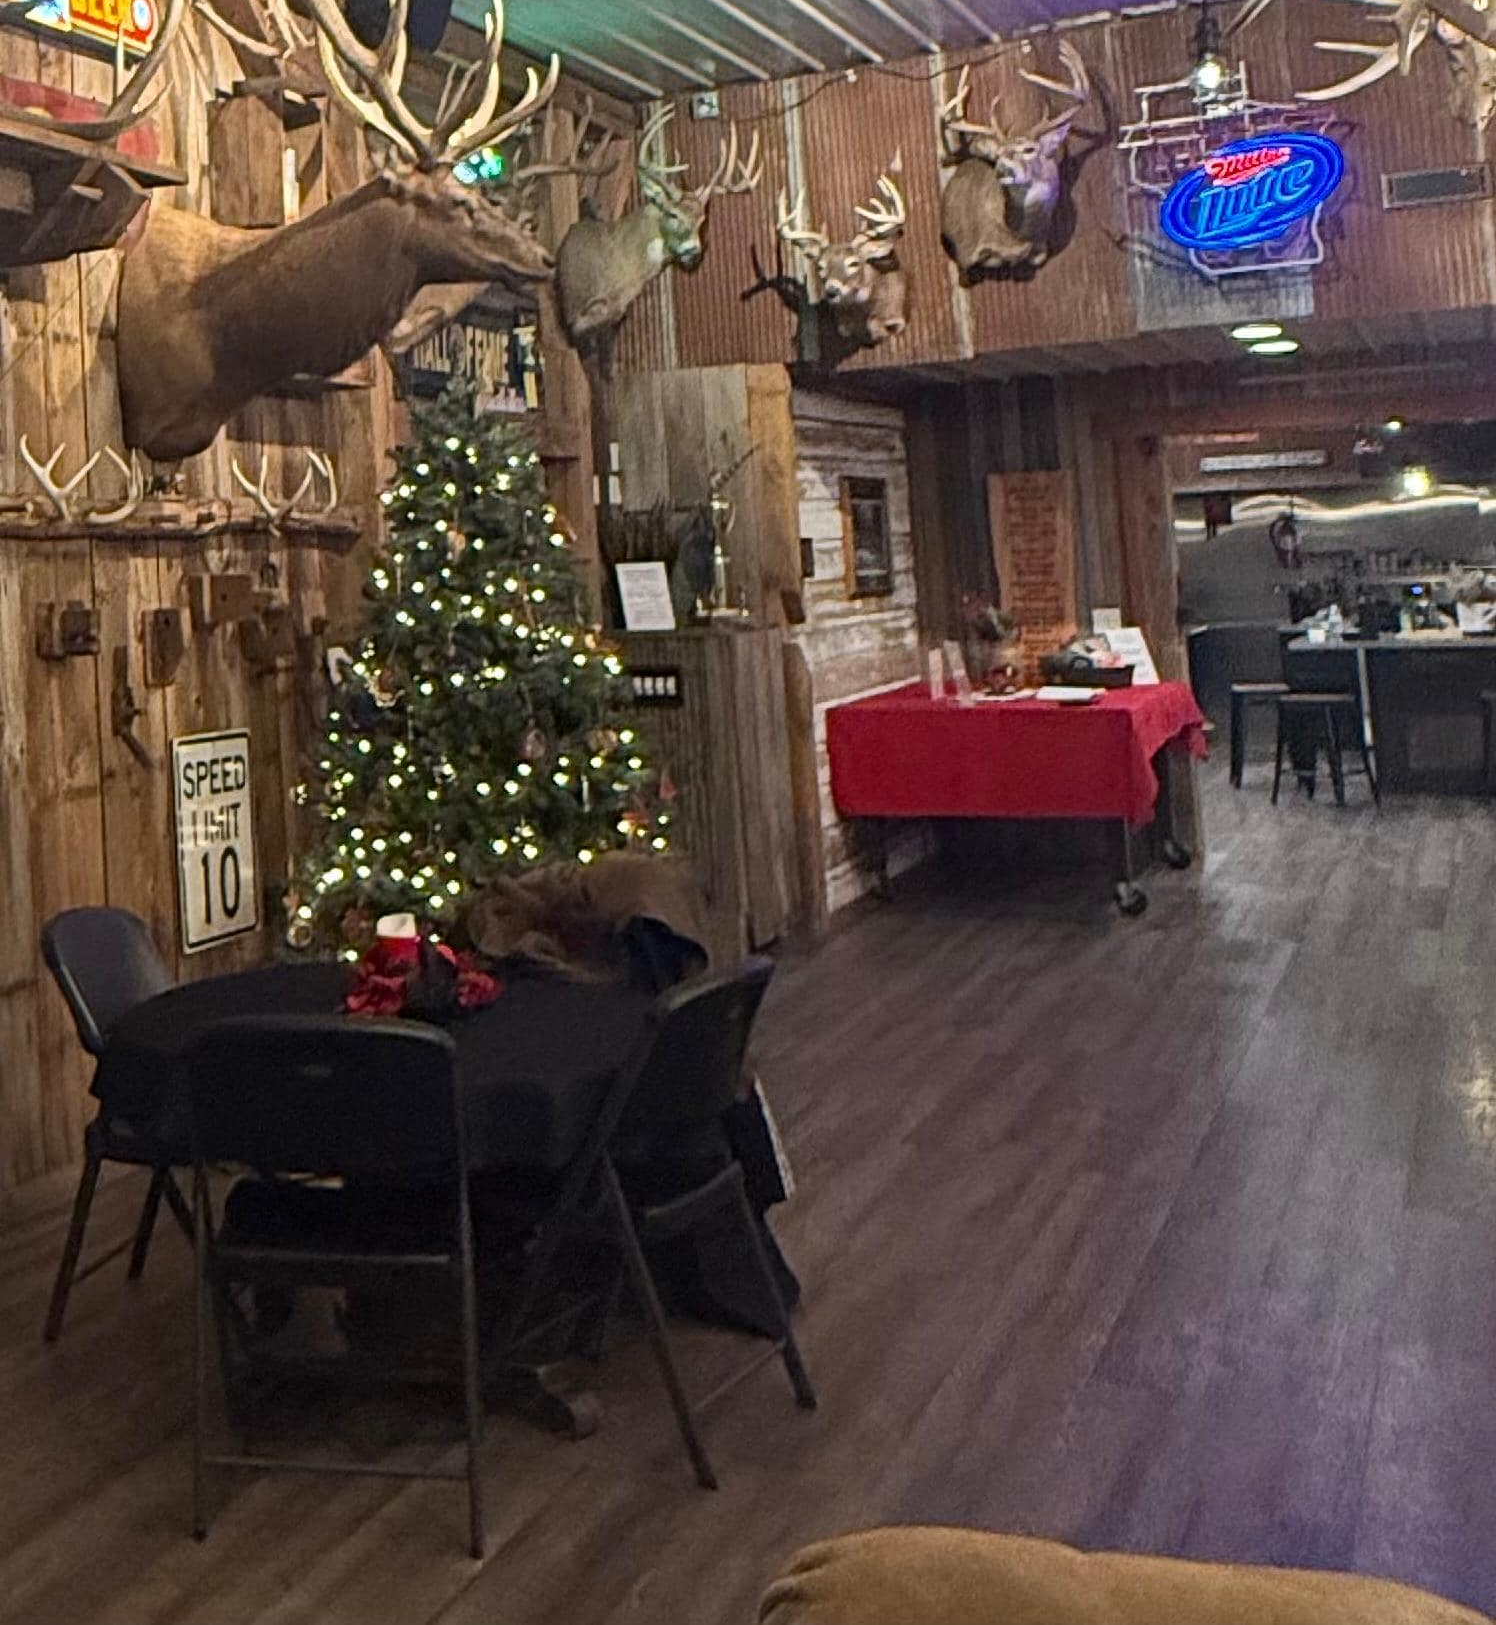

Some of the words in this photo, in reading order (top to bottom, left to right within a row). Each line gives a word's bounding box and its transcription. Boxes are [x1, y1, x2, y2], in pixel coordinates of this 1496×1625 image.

[1197, 159, 1314, 238] Lite
[182, 755, 246, 799] SPEED
[191, 803, 240, 847] LIMIT
[201, 846, 240, 925] 10
